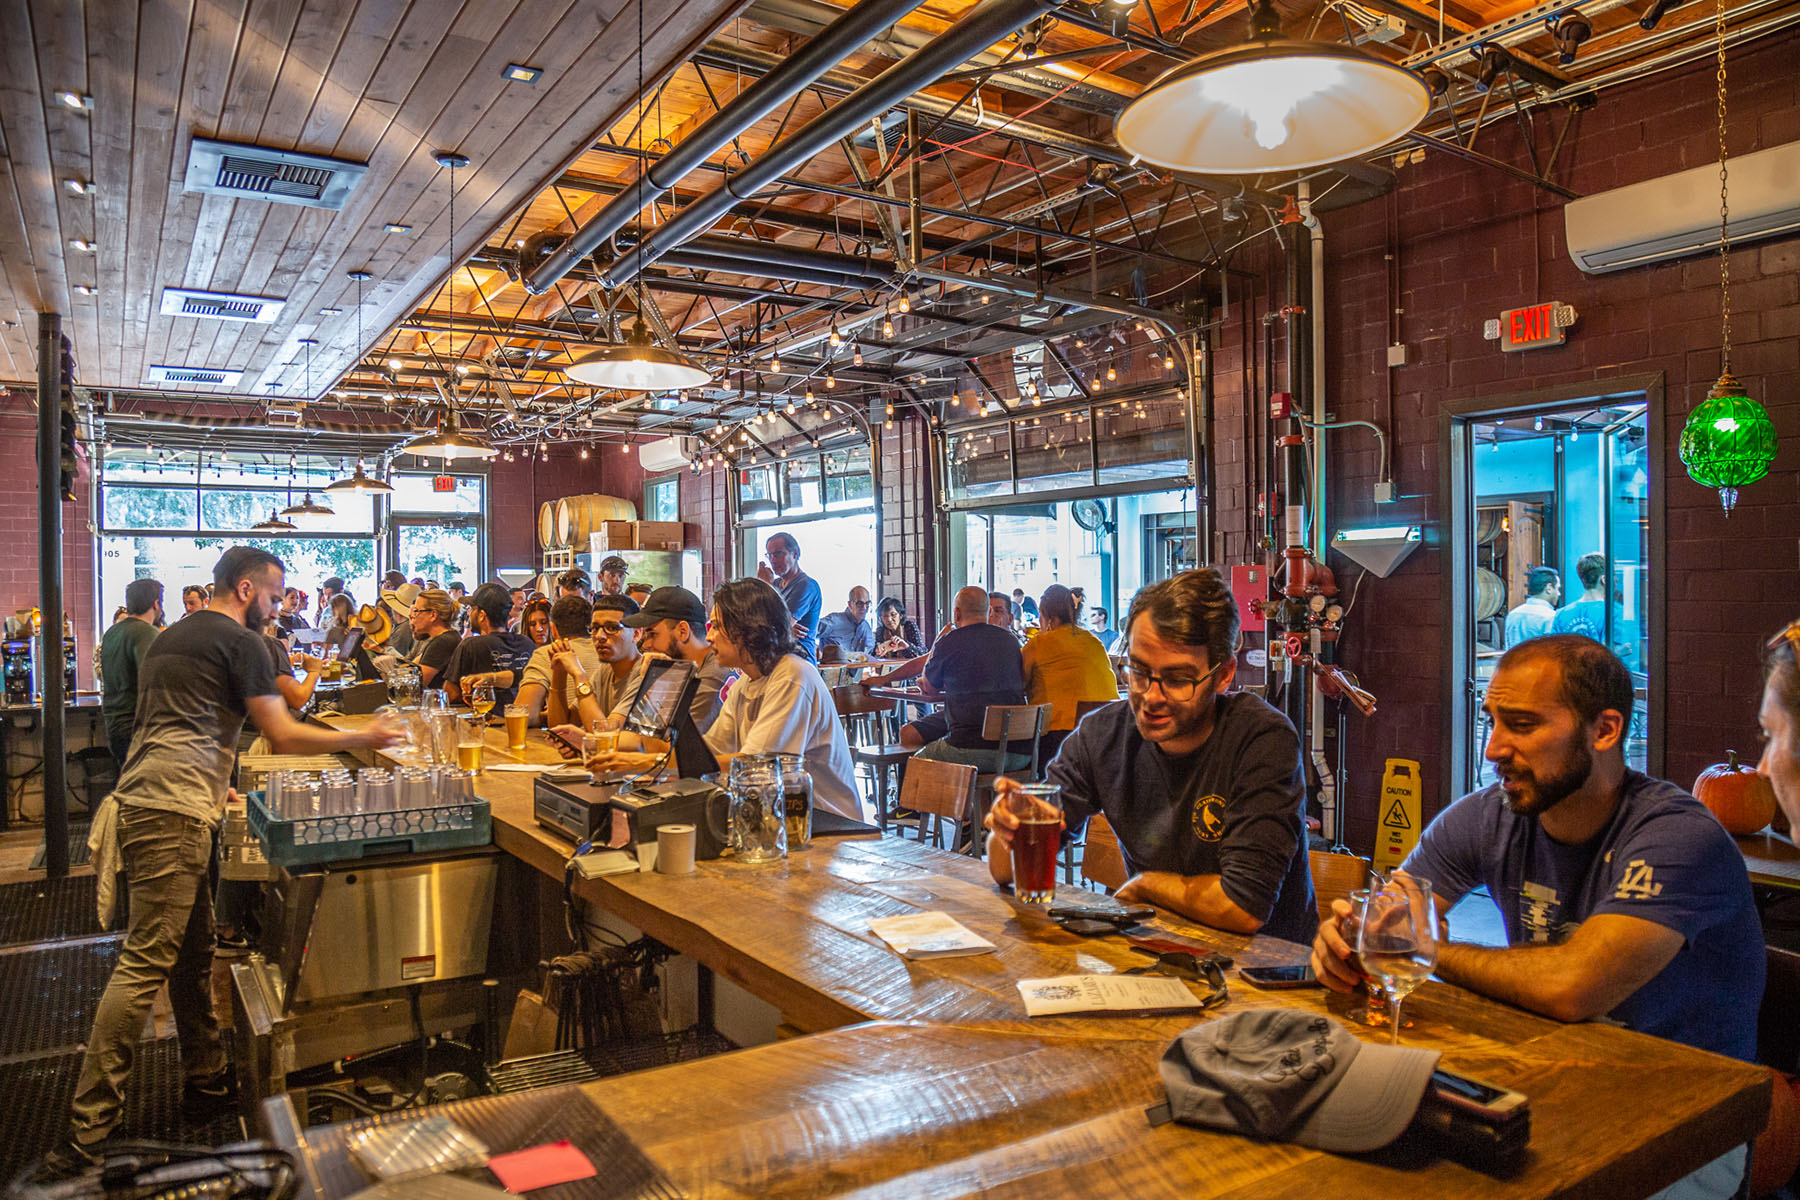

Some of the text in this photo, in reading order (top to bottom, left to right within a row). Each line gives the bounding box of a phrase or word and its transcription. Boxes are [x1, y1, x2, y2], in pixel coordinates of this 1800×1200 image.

[1510, 304, 1553, 345] EXIT
[436, 476, 455, 492] EXIT
[1386, 786, 1413, 797] CAUTION
[1614, 859, 1664, 900] LA
